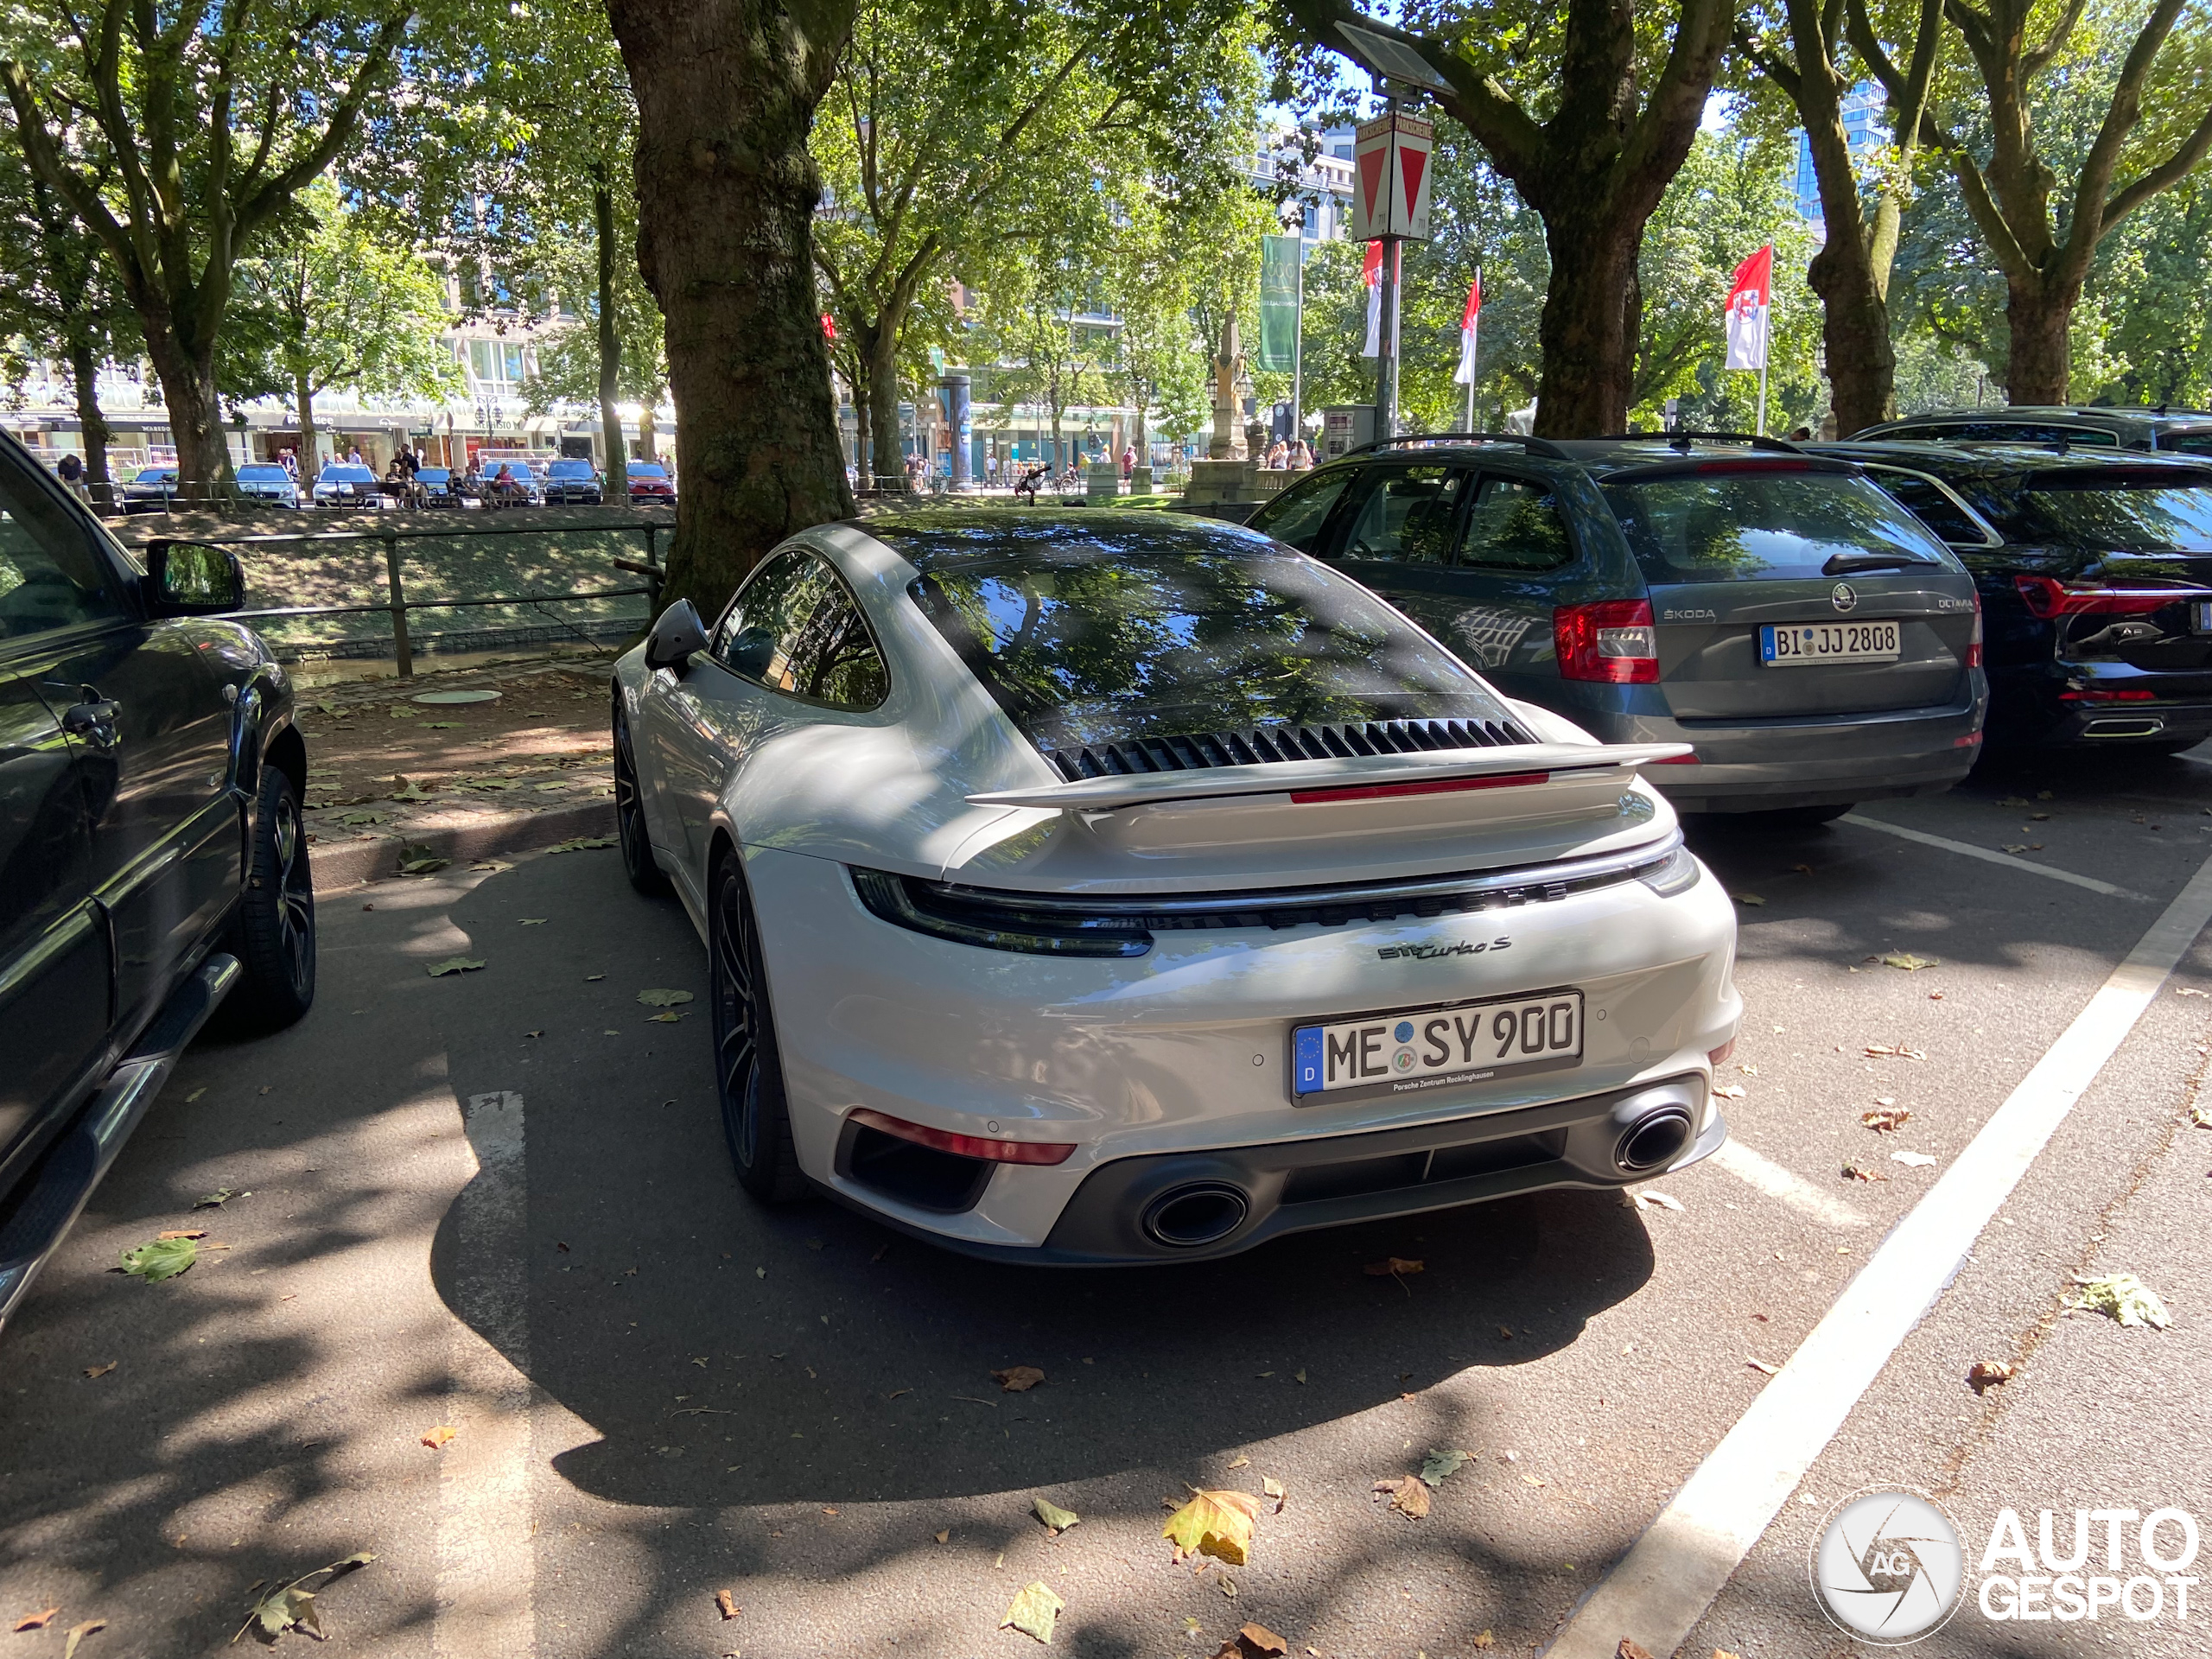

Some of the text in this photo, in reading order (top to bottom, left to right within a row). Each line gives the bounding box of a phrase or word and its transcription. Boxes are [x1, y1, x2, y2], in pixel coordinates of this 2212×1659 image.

[1356, 118, 1393, 142] PARKSCHEINE
[1395, 116, 1432, 139] PARKSCHEINE
[474, 420, 512, 429] MEPHISTO
[1663, 608, 1716, 620] ŠKODA
[1938, 599, 1974, 609] OCTAVIA
[1777, 630, 1802, 656] BI
[1818, 628, 1843, 653] JJ
[1847, 626, 1896, 652] 2808
[1488, 935, 1513, 952] S
[1305, 1066, 1315, 1082] D
[1327, 1027, 1389, 1082] ME
[1422, 1014, 1481, 1068] SY
[1492, 1002, 1573, 1059] 900
[1393, 1071, 1494, 1092] Porsche Zentrum Recklinghausen
